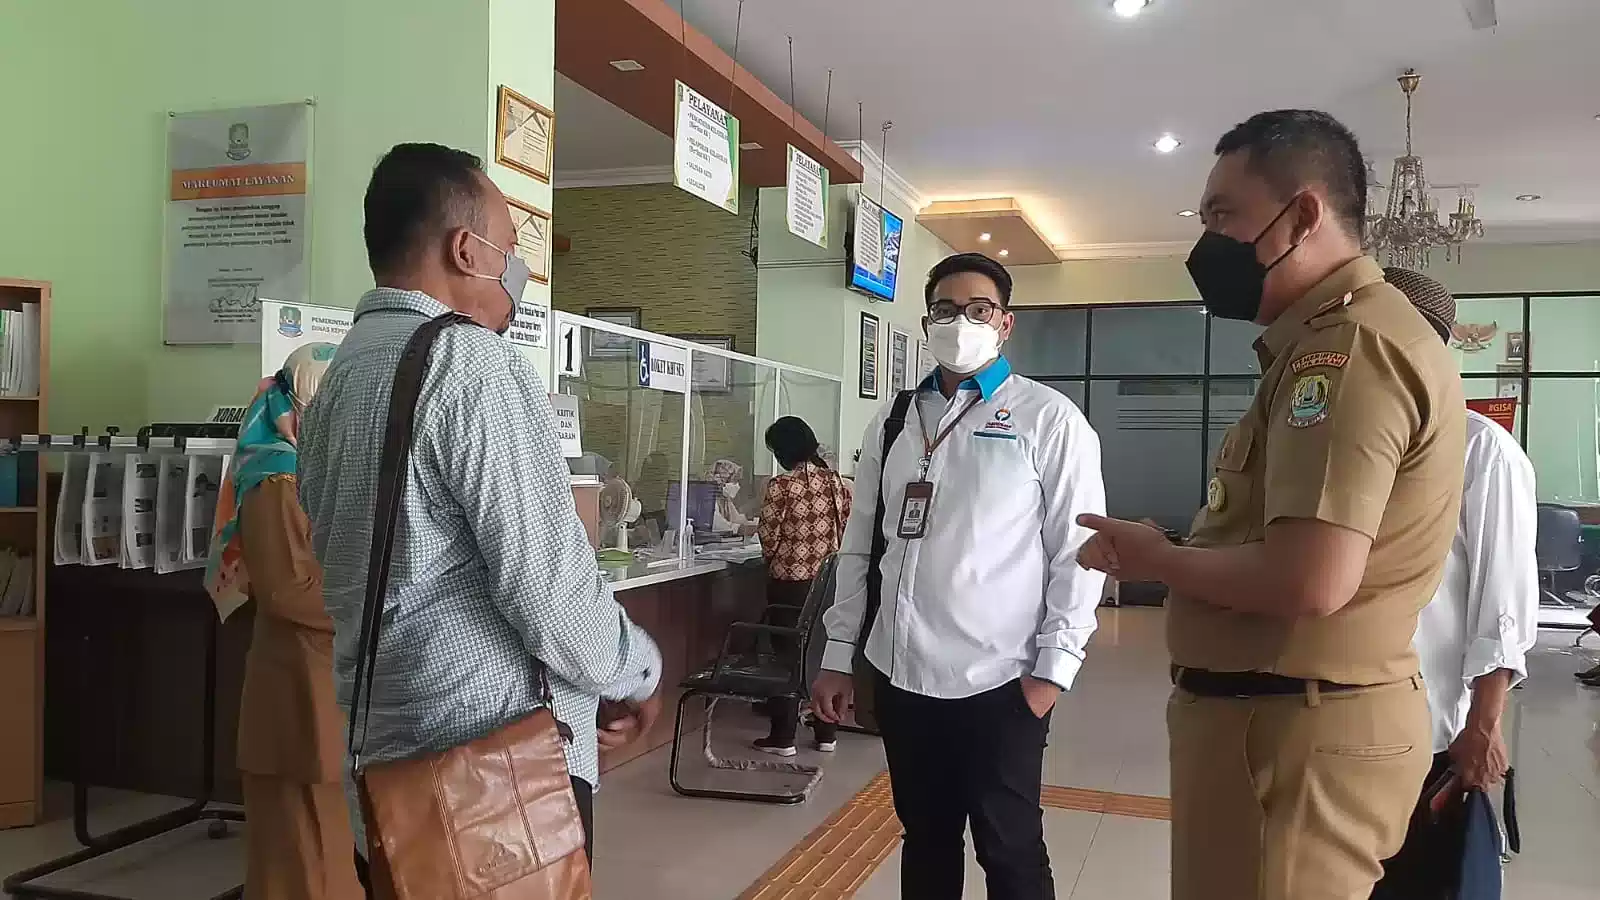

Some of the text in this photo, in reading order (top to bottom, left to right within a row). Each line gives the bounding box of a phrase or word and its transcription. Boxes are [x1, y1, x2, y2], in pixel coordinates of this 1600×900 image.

[182, 174, 295, 190] MAKLUMAT LAYANAN
[564, 327, 573, 372] 1
[556, 408, 575, 418] KRITIK
[560, 420, 572, 429] DAN
